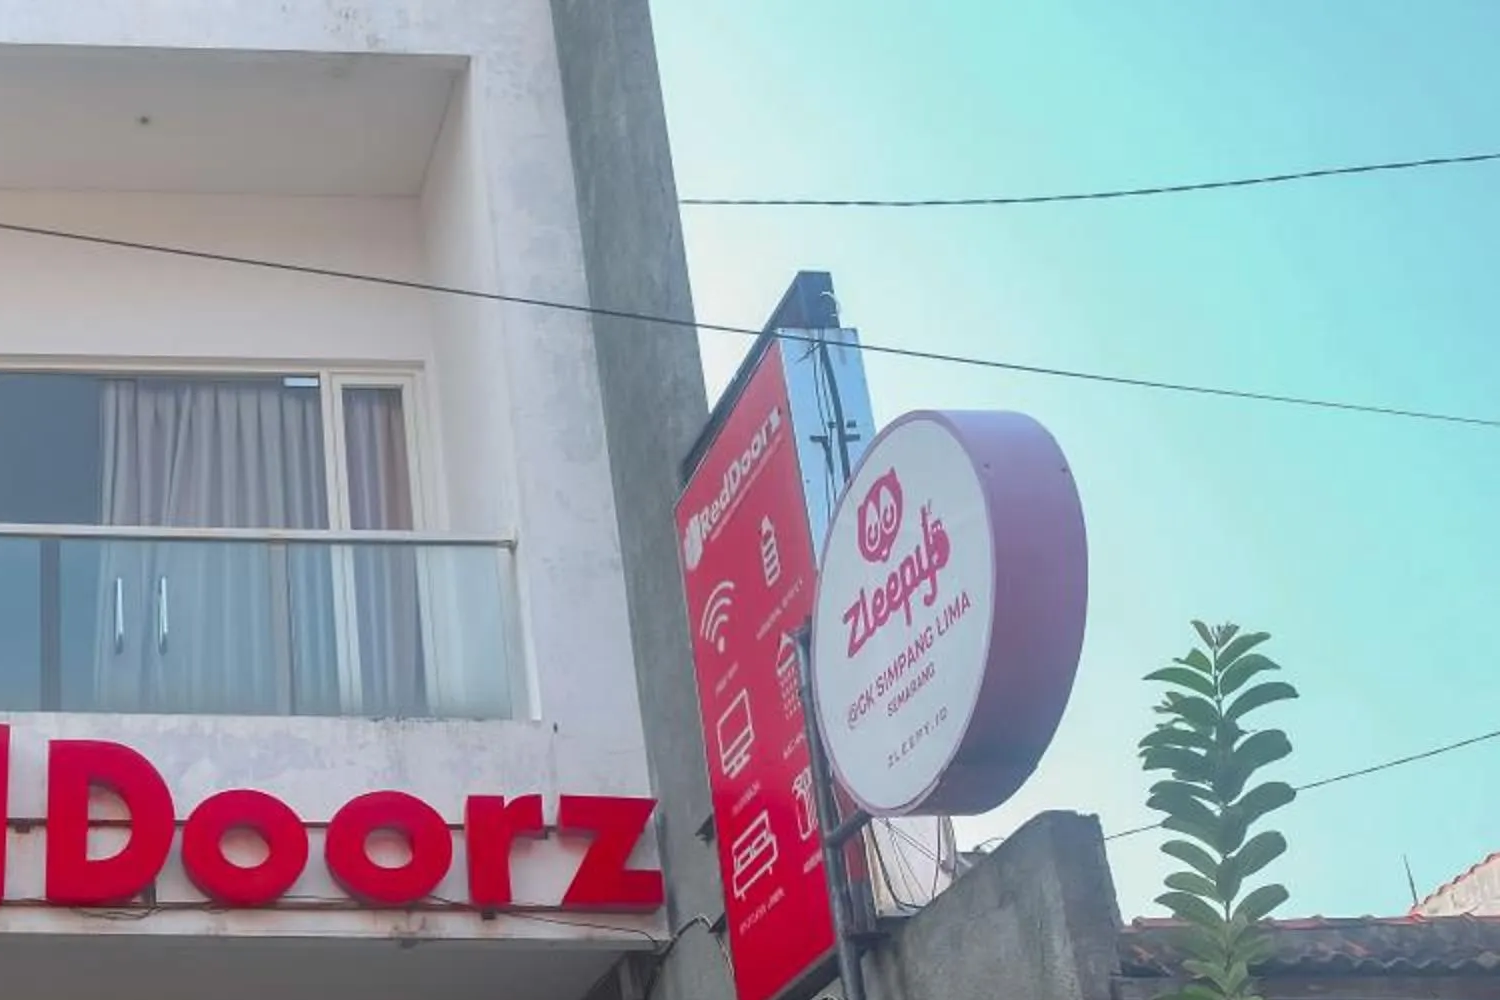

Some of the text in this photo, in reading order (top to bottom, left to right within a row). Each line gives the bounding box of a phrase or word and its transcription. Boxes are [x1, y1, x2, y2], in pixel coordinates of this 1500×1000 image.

[875, 625, 934, 698] SIMPANG
[935, 591, 971, 637] LIMA
[886, 660, 936, 718] SEMARANG
